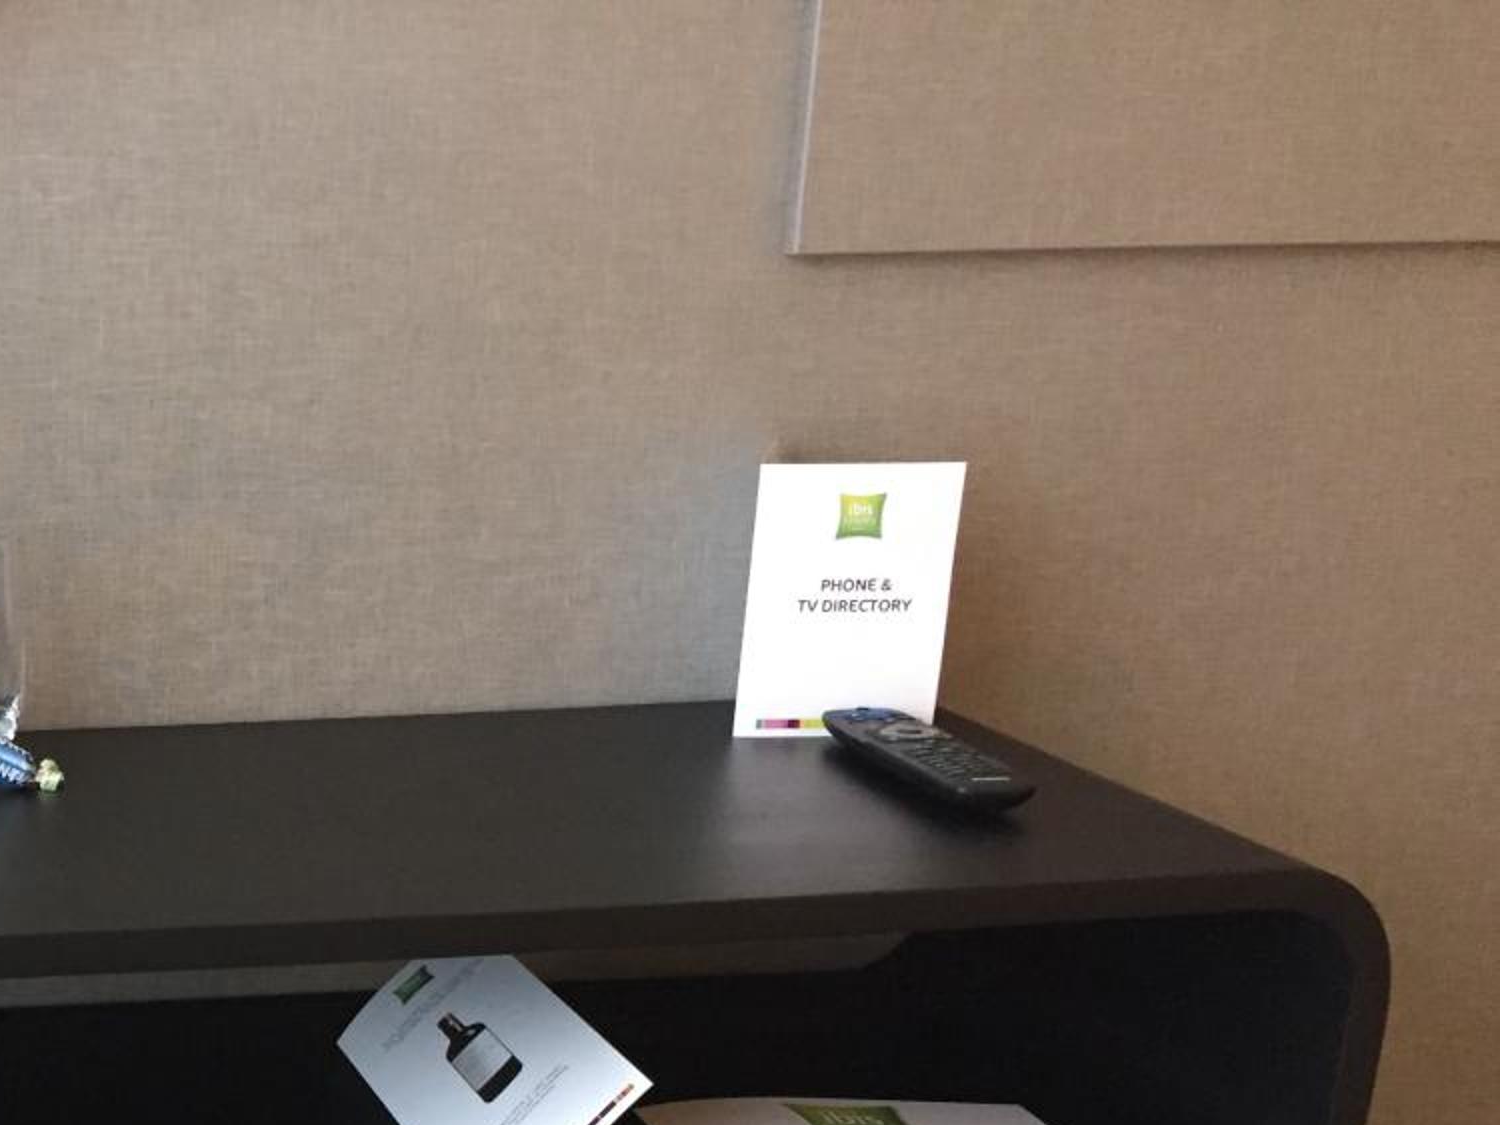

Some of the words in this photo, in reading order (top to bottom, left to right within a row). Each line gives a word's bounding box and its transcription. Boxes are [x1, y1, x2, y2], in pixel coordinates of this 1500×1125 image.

[821, 578, 877, 592] PHONE
[881, 579, 892, 591] &
[798, 599, 819, 612] TV
[821, 599, 912, 613] DIRECTORY
